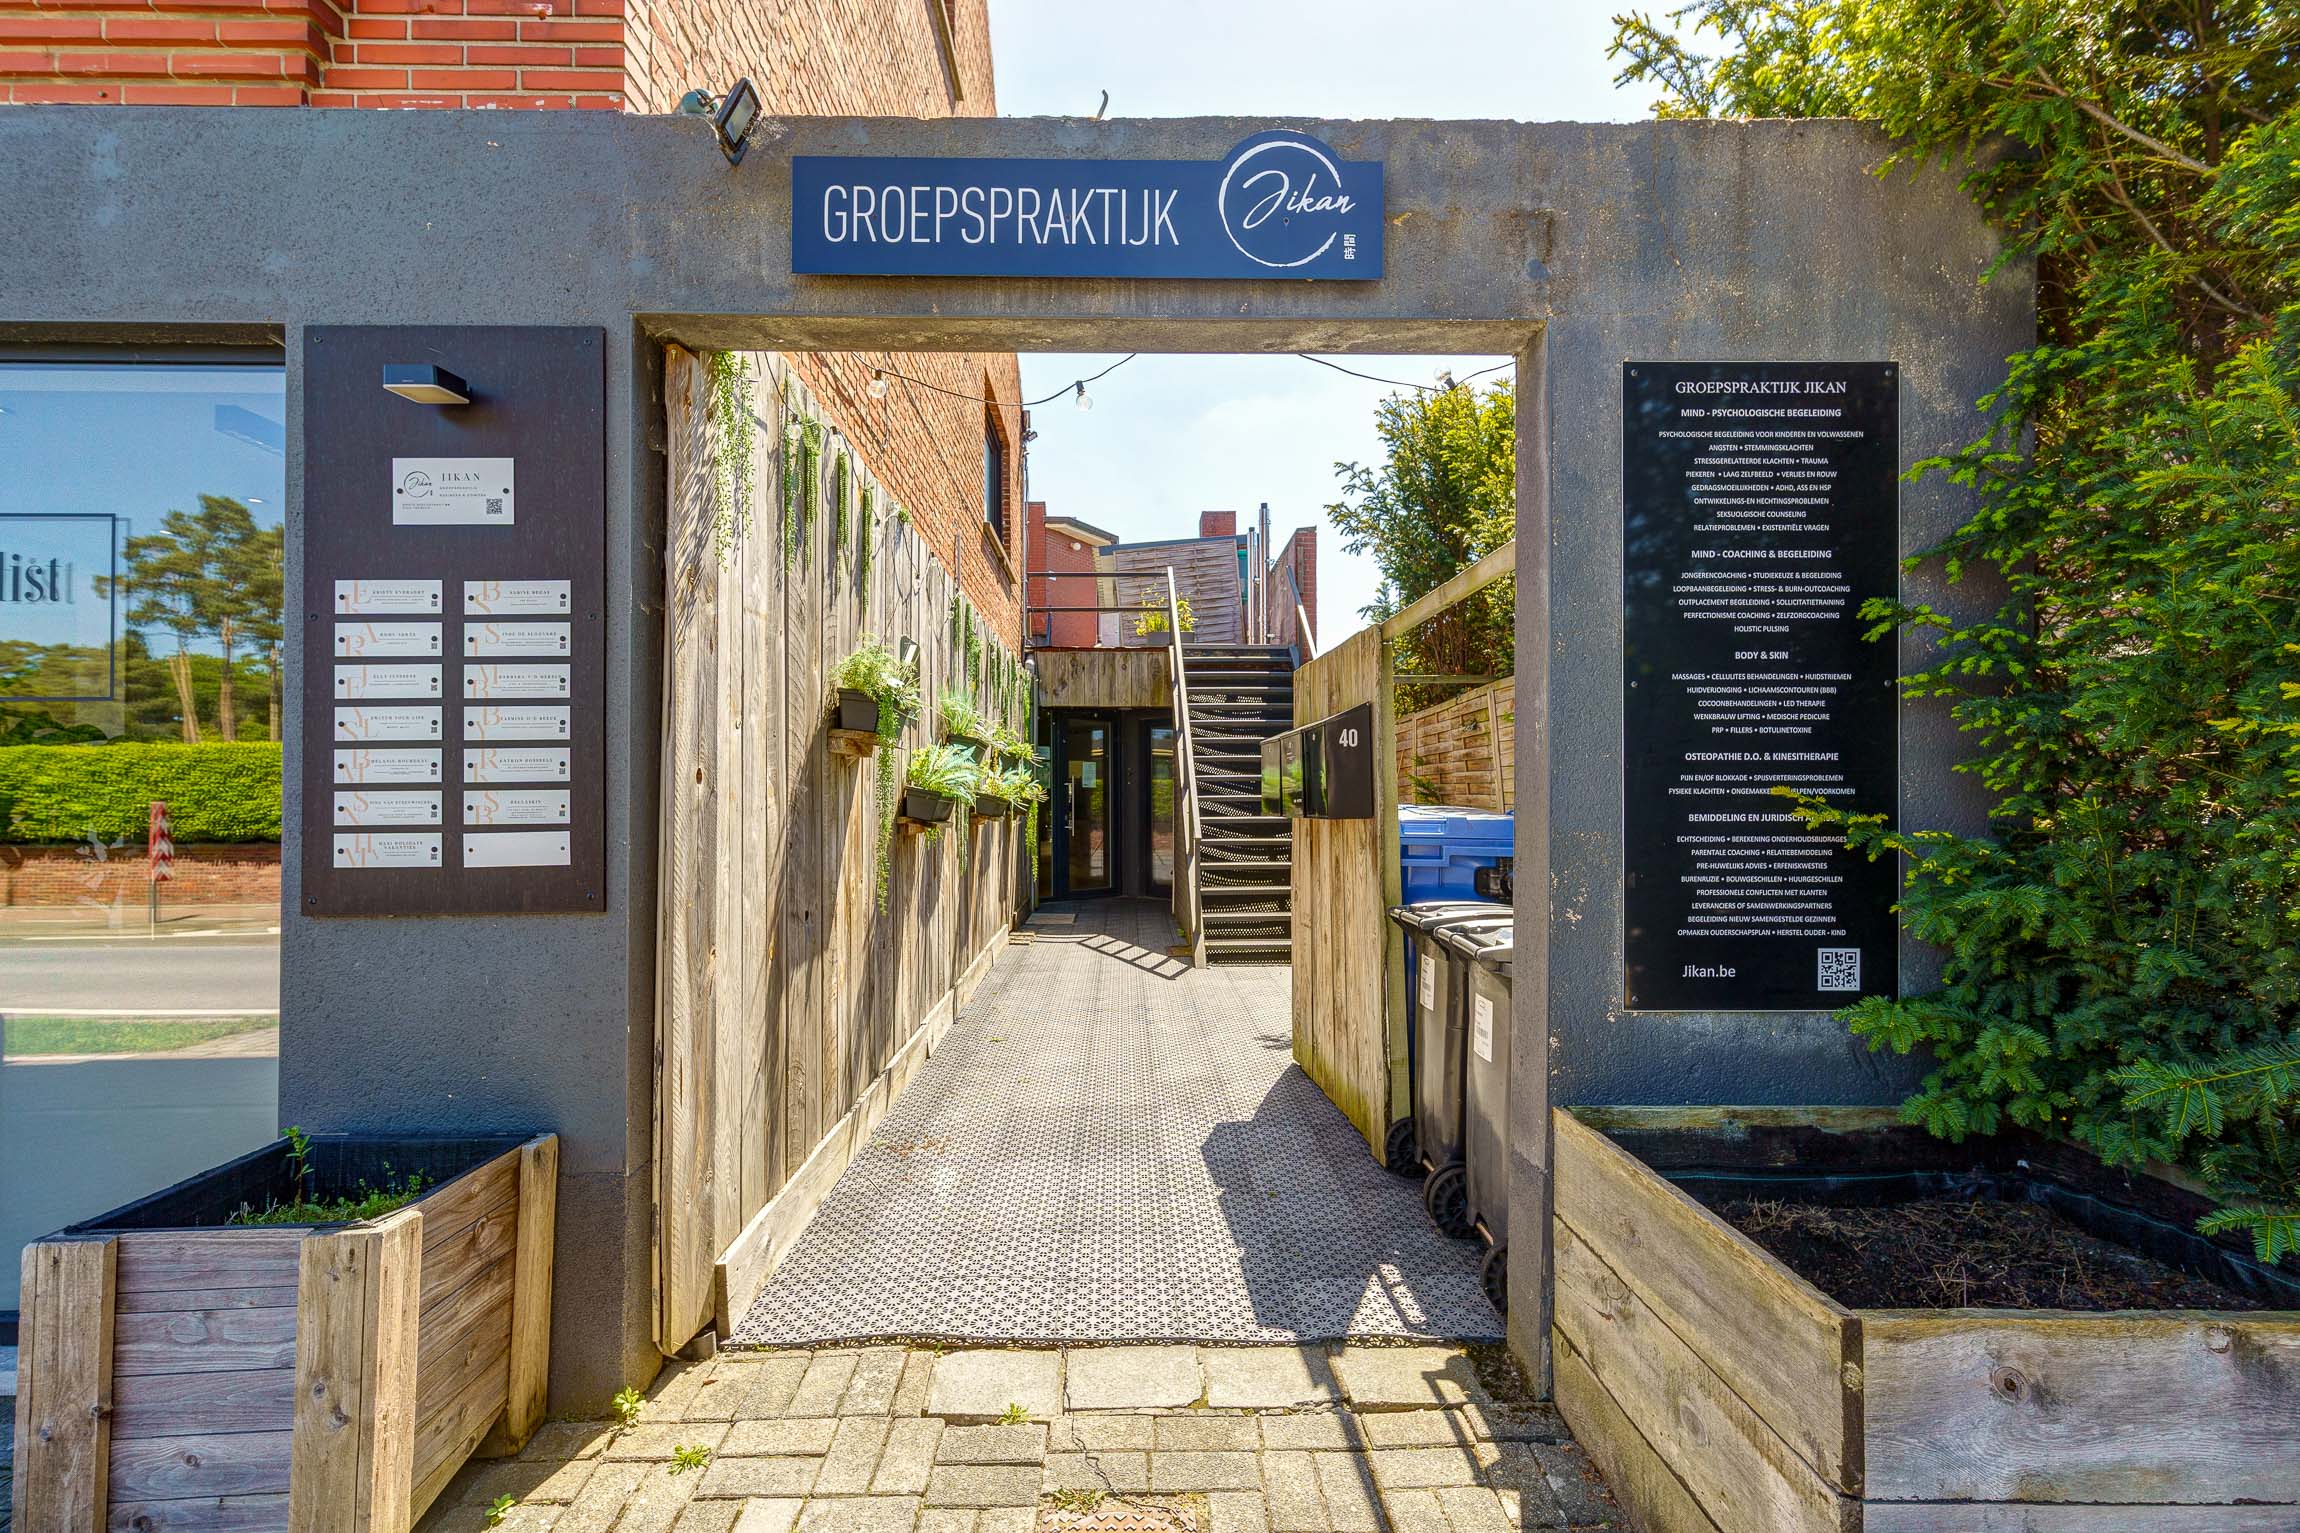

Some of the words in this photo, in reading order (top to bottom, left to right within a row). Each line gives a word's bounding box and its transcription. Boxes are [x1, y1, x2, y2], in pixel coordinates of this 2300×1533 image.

[1242, 169, 1357, 230] Jikan
[823, 185, 1180, 246] GROEPSPRAKTIJK
[1675, 381, 1800, 393] GROEPSPRAKTIJK
[1804, 381, 1846, 393] JIKAN
[1681, 408, 1704, 418] MIND
[1712, 408, 1785, 418] PSYCHOLOGISCHE
[1787, 408, 1841, 418] BEGELEIDING
[1659, 430, 1713, 438] PSYCHOLOGISCHE
[1714, 430, 1754, 438] BEGELEIDING
[1756, 430, 1773, 438] VOOR
[1775, 430, 1806, 438] KINDEREN
[1807, 430, 1816, 438] EN
[1817, 430, 1863, 438] VOLWASSENEN
[1709, 444, 1738, 452] ANGSTEN
[1745, 444, 1813, 452] STEMMINGSKLACHTEN
[1694, 457, 1761, 465] STRESSGERELATEERDE
[1763, 457, 1794, 465] KLACHTEN
[1802, 457, 1828, 465] TRAUMA
[441, 472, 481, 482] JIKAN
[1686, 470, 1715, 478] PIEKEREN
[1723, 470, 1740, 478] LAAG
[1741, 470, 1773, 478] ZELFBEELD
[1781, 470, 1805, 478] VERLIES
[1807, 470, 1815, 478] EN
[1817, 470, 1837, 478] ROUW
[1776, 484, 1795, 493] ADHD,
[1797, 484, 1808, 492] ASS
[1809, 484, 1818, 492] EN
[1820, 484, 1831, 492] HSP
[1756, 497, 1829, 505] HECHTINGSPROBLEMEN
[1767, 510, 1806, 518] COUNSELING
[1694, 524, 1755, 532] RELATIEPROBLEMEN
[1762, 522, 1802, 532] EXISTENTIËLE
[1804, 524, 1829, 532] VRAGEN
[1692, 549, 1715, 559] MIND
[1723, 549, 1766, 559] COACHING
[1769, 549, 1775, 559] &
[1778, 549, 1831, 559] BEGELEIDING
[1681, 571, 1746, 579] JONGERENCOACHING
[1753, 571, 1793, 579] STUDIEKEUZE
[1795, 571, 1800, 579] &
[1802, 571, 1841, 579] BEGELEIDING
[1673, 585, 1746, 593] LOOPBAANBEGELEIDING
[1753, 585, 1777, 593] STRESS-
[1779, 585, 1783, 593] &
[1785, 585, 1850, 593] BURN-OUTCOACHING
[1679, 598, 1728, 606] OUTPLACEMENT
[1730, 598, 1770, 606] BEGELEIDING
[1777, 598, 1844, 606] SOLLICITATIETRAINING
[1684, 611, 1736, 619] PERFECTIONISME
[1737, 611, 1770, 619] COACHING
[1777, 611, 1839, 619] ZELFZORGCOACHING
[1734, 625, 1761, 633] HOLISTIC
[1763, 625, 1789, 633] PULSING
[1735, 651, 1758, 660] BODY
[1761, 651, 1767, 660] &
[1770, 651, 1788, 660] SKIN
[1672, 673, 1705, 681] MASSAGES
[1712, 673, 1745, 681] CELLULITES
[1747, 673, 1798, 681] BEHANDELINGEN
[1805, 673, 1851, 681] HUIDSTRIEMEN
[1749, 686, 1818, 694] LICHAAMSCONTOUREN
[1698, 699, 1777, 707] COCOONBEHANDELINGEN
[1784, 699, 1795, 707] LED
[1797, 699, 1825, 707] THERAPIE
[1694, 713, 1736, 721] WENKBRAUW
[1737, 713, 1760, 721] LIFTING
[1767, 713, 1798, 721] MEDISCHE
[1800, 713, 1829, 721] PEDICURE
[1712, 726, 1723, 734] PRP
[1730, 726, 1752, 734] FILLERS
[1759, 726, 1811, 734] BOTULINETOXINE
[1338, 728, 1358, 748] 40
[1686, 752, 1742, 761] OSTEOPATHIE
[1744, 752, 1761, 761] D.O.
[1764, 752, 1770, 761] &
[1773, 752, 1838, 761] KINESITHERAPIE
[1681, 774, 1693, 782] PIJN
[1695, 774, 1714, 782] EN/OF
[1716, 774, 1747, 782] BLOKKADE
[1669, 787, 1691, 795] FYSIEKE
[1693, 787, 1724, 795] KLACHTEN
[1731, 787, 1774, 795] ONGEMAKKE
[1689, 813, 1746, 822] BEMIDDELING
[1748, 813, 1759, 822] EN
[1677, 835, 1725, 843] ECHTSCHEIDING
[1732, 835, 1770, 843] BEREKENING
[1691, 848, 1726, 856] PARENTALE
[1727, 848, 1760, 856] COACHING
[1766, 848, 1833, 856] RELATIEBEMIDDELING
[1745, 862, 1767, 870] ADVIES
[1774, 862, 1827, 870] ERFENISKWESTIES
[1726, 875, 1782, 883] BOUWGESCHILLEN
[1789, 875, 1842, 883] HUURGESCHILLEN
[1692, 902, 1735, 910] LEVERANCIERS
[1737, 902, 1745, 910] OF
[1747, 902, 1832, 910] SAMENWERKINGSPARTNERS
[1688, 915, 1727, 923] BEGELEIDING
[1729, 915, 1750, 923] NIEUW
[1752, 915, 1803, 923] SAMENGESTELDE
[1805, 915, 1836, 923] GEZINNEN
[1678, 928, 1709, 936] OPMAKEN
[1710, 928, 1770, 936] OUDERSCHAPSPLAN
[1777, 928, 1802, 936] HERSTEL
[1804, 928, 1826, 936] OUDER
[1831, 928, 1846, 936] KIND
[1682, 964, 1735, 978] Jikan.be
